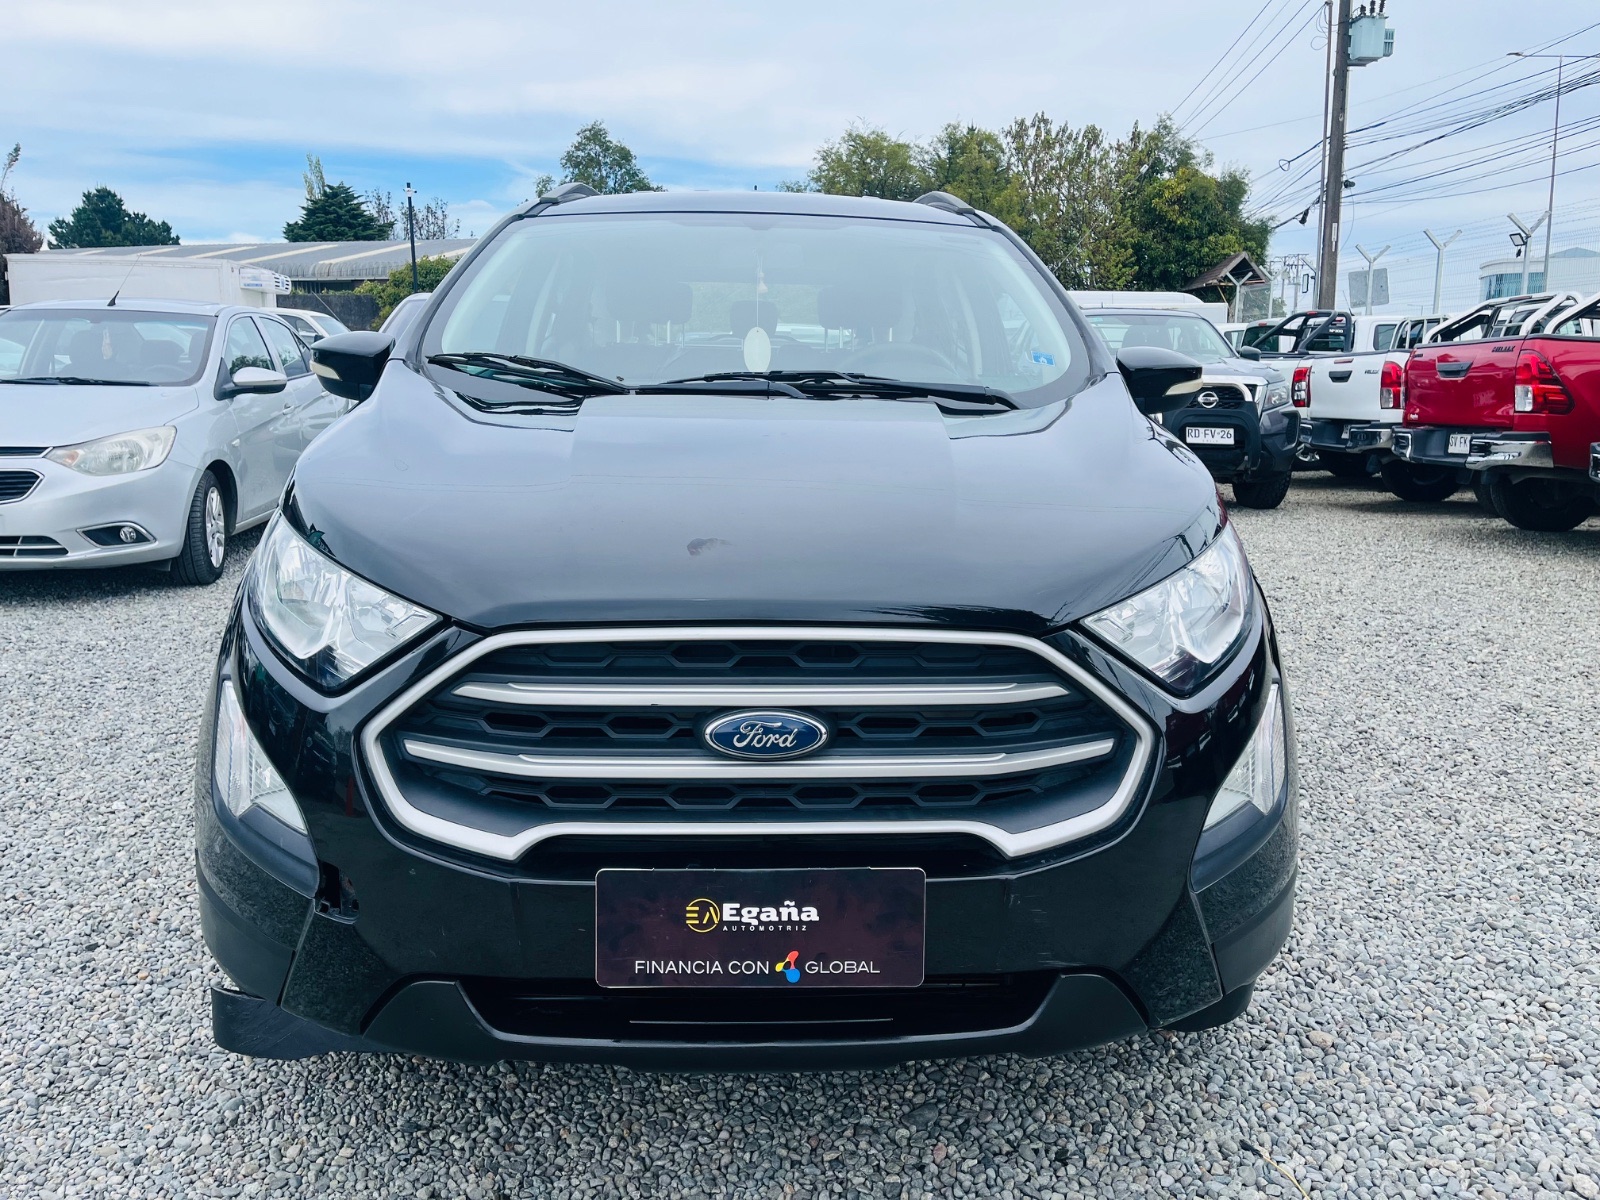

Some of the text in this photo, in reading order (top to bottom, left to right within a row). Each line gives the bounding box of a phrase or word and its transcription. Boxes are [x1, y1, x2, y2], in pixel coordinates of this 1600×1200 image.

[733, 720, 798, 748] Ford
[722, 900, 820, 926] Egaña
[635, 960, 880, 974] FINANCIA CON GLOBAL
